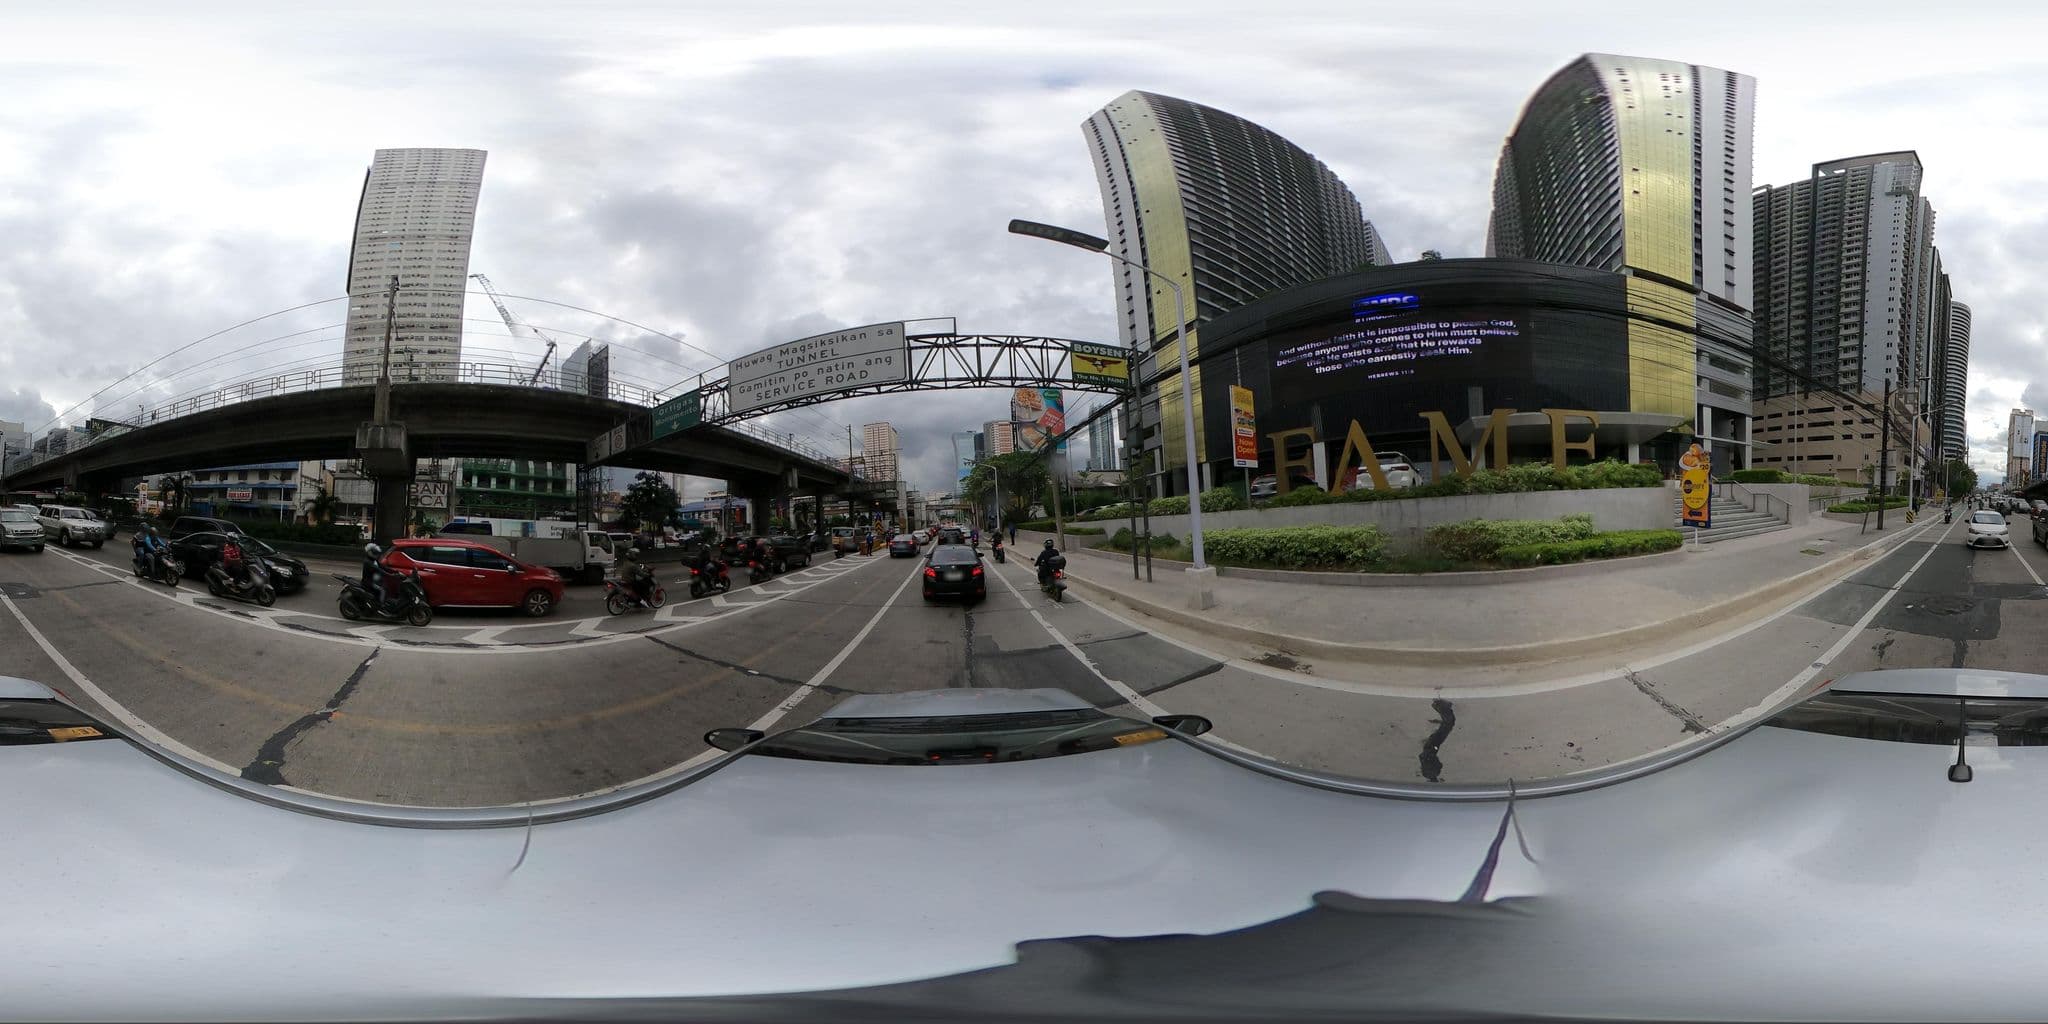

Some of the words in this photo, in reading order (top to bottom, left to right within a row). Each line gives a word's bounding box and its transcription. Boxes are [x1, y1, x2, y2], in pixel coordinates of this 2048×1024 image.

[735, 353, 772, 371] Huwag
[779, 331, 867, 357] Magsiksikan
[877, 327, 894, 337] sa
[1074, 344, 1122, 357] BOYSEN
[1279, 347, 1295, 356] And
[1357, 331, 1365, 339] it
[1367, 329, 1376, 337] is
[1378, 322, 1437, 335] impossible
[1315, 344, 1349, 356] anyone
[1375, 333, 1411, 343] comes
[1426, 329, 1448, 338] Him
[1450, 328, 1477, 336] must
[1342, 348, 1372, 358] exists
[1396, 341, 1418, 349] that
[1421, 340, 1436, 348] He
[1438, 337, 1482, 346] rewards
[776, 347, 840, 370] TUNNEL
[1315, 363, 1342, 374] those
[1367, 350, 1417, 363] earnestly
[1448, 346, 1472, 355] Him.
[738, 373, 785, 394] Gamitin
[794, 369, 808, 382] po
[816, 360, 855, 376] natin
[865, 355, 893, 367] ang
[755, 379, 816, 401] SERVICE
[825, 369, 869, 386] ROAD
[655, 406, 698, 426] Monumento
[658, 398, 694, 416] Ortigas
[1238, 438, 1254, 446] Now
[1266, 408, 1600, 495] FAME
